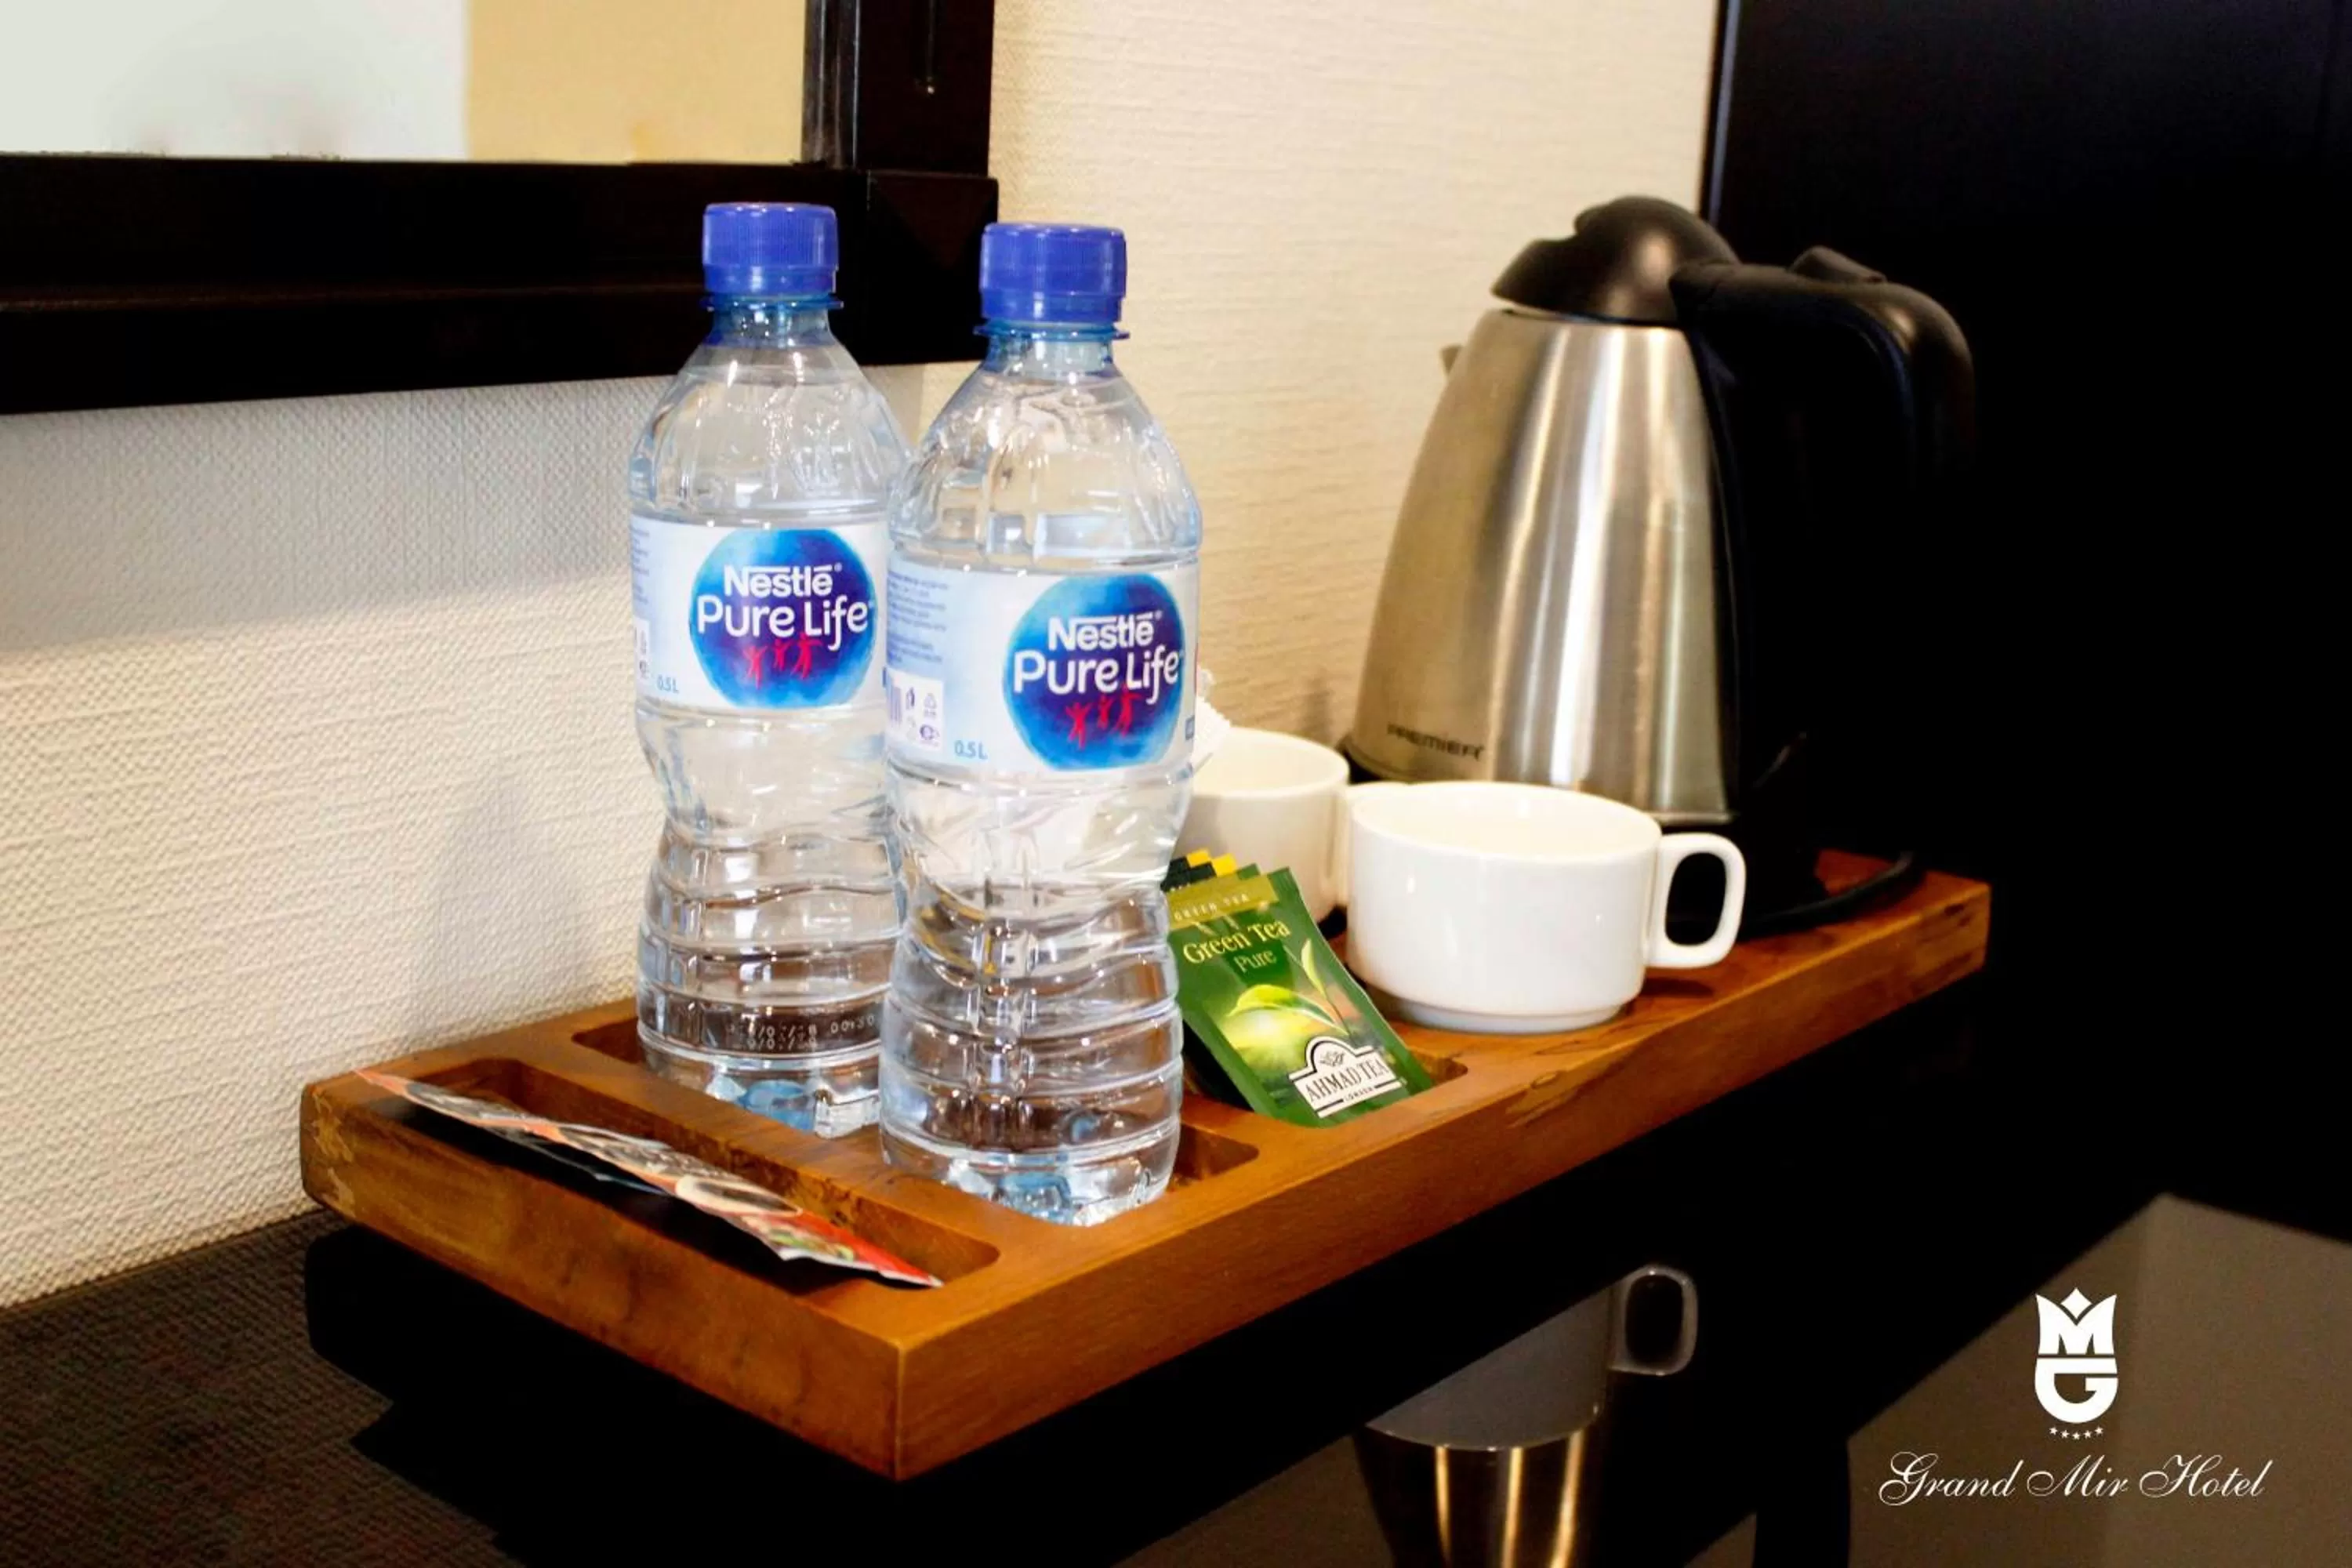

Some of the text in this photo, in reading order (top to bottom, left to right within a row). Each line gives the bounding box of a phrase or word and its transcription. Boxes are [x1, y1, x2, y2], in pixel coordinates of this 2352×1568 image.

[697, 594, 795, 637] Pure
[804, 595, 869, 652] Life
[1014, 644, 1179, 705] Pure Life
[1182, 920, 1291, 964] Green Tea
[1233, 949, 1277, 974] Pure
[1305, 1058, 1391, 1102] AHMAD TEA
